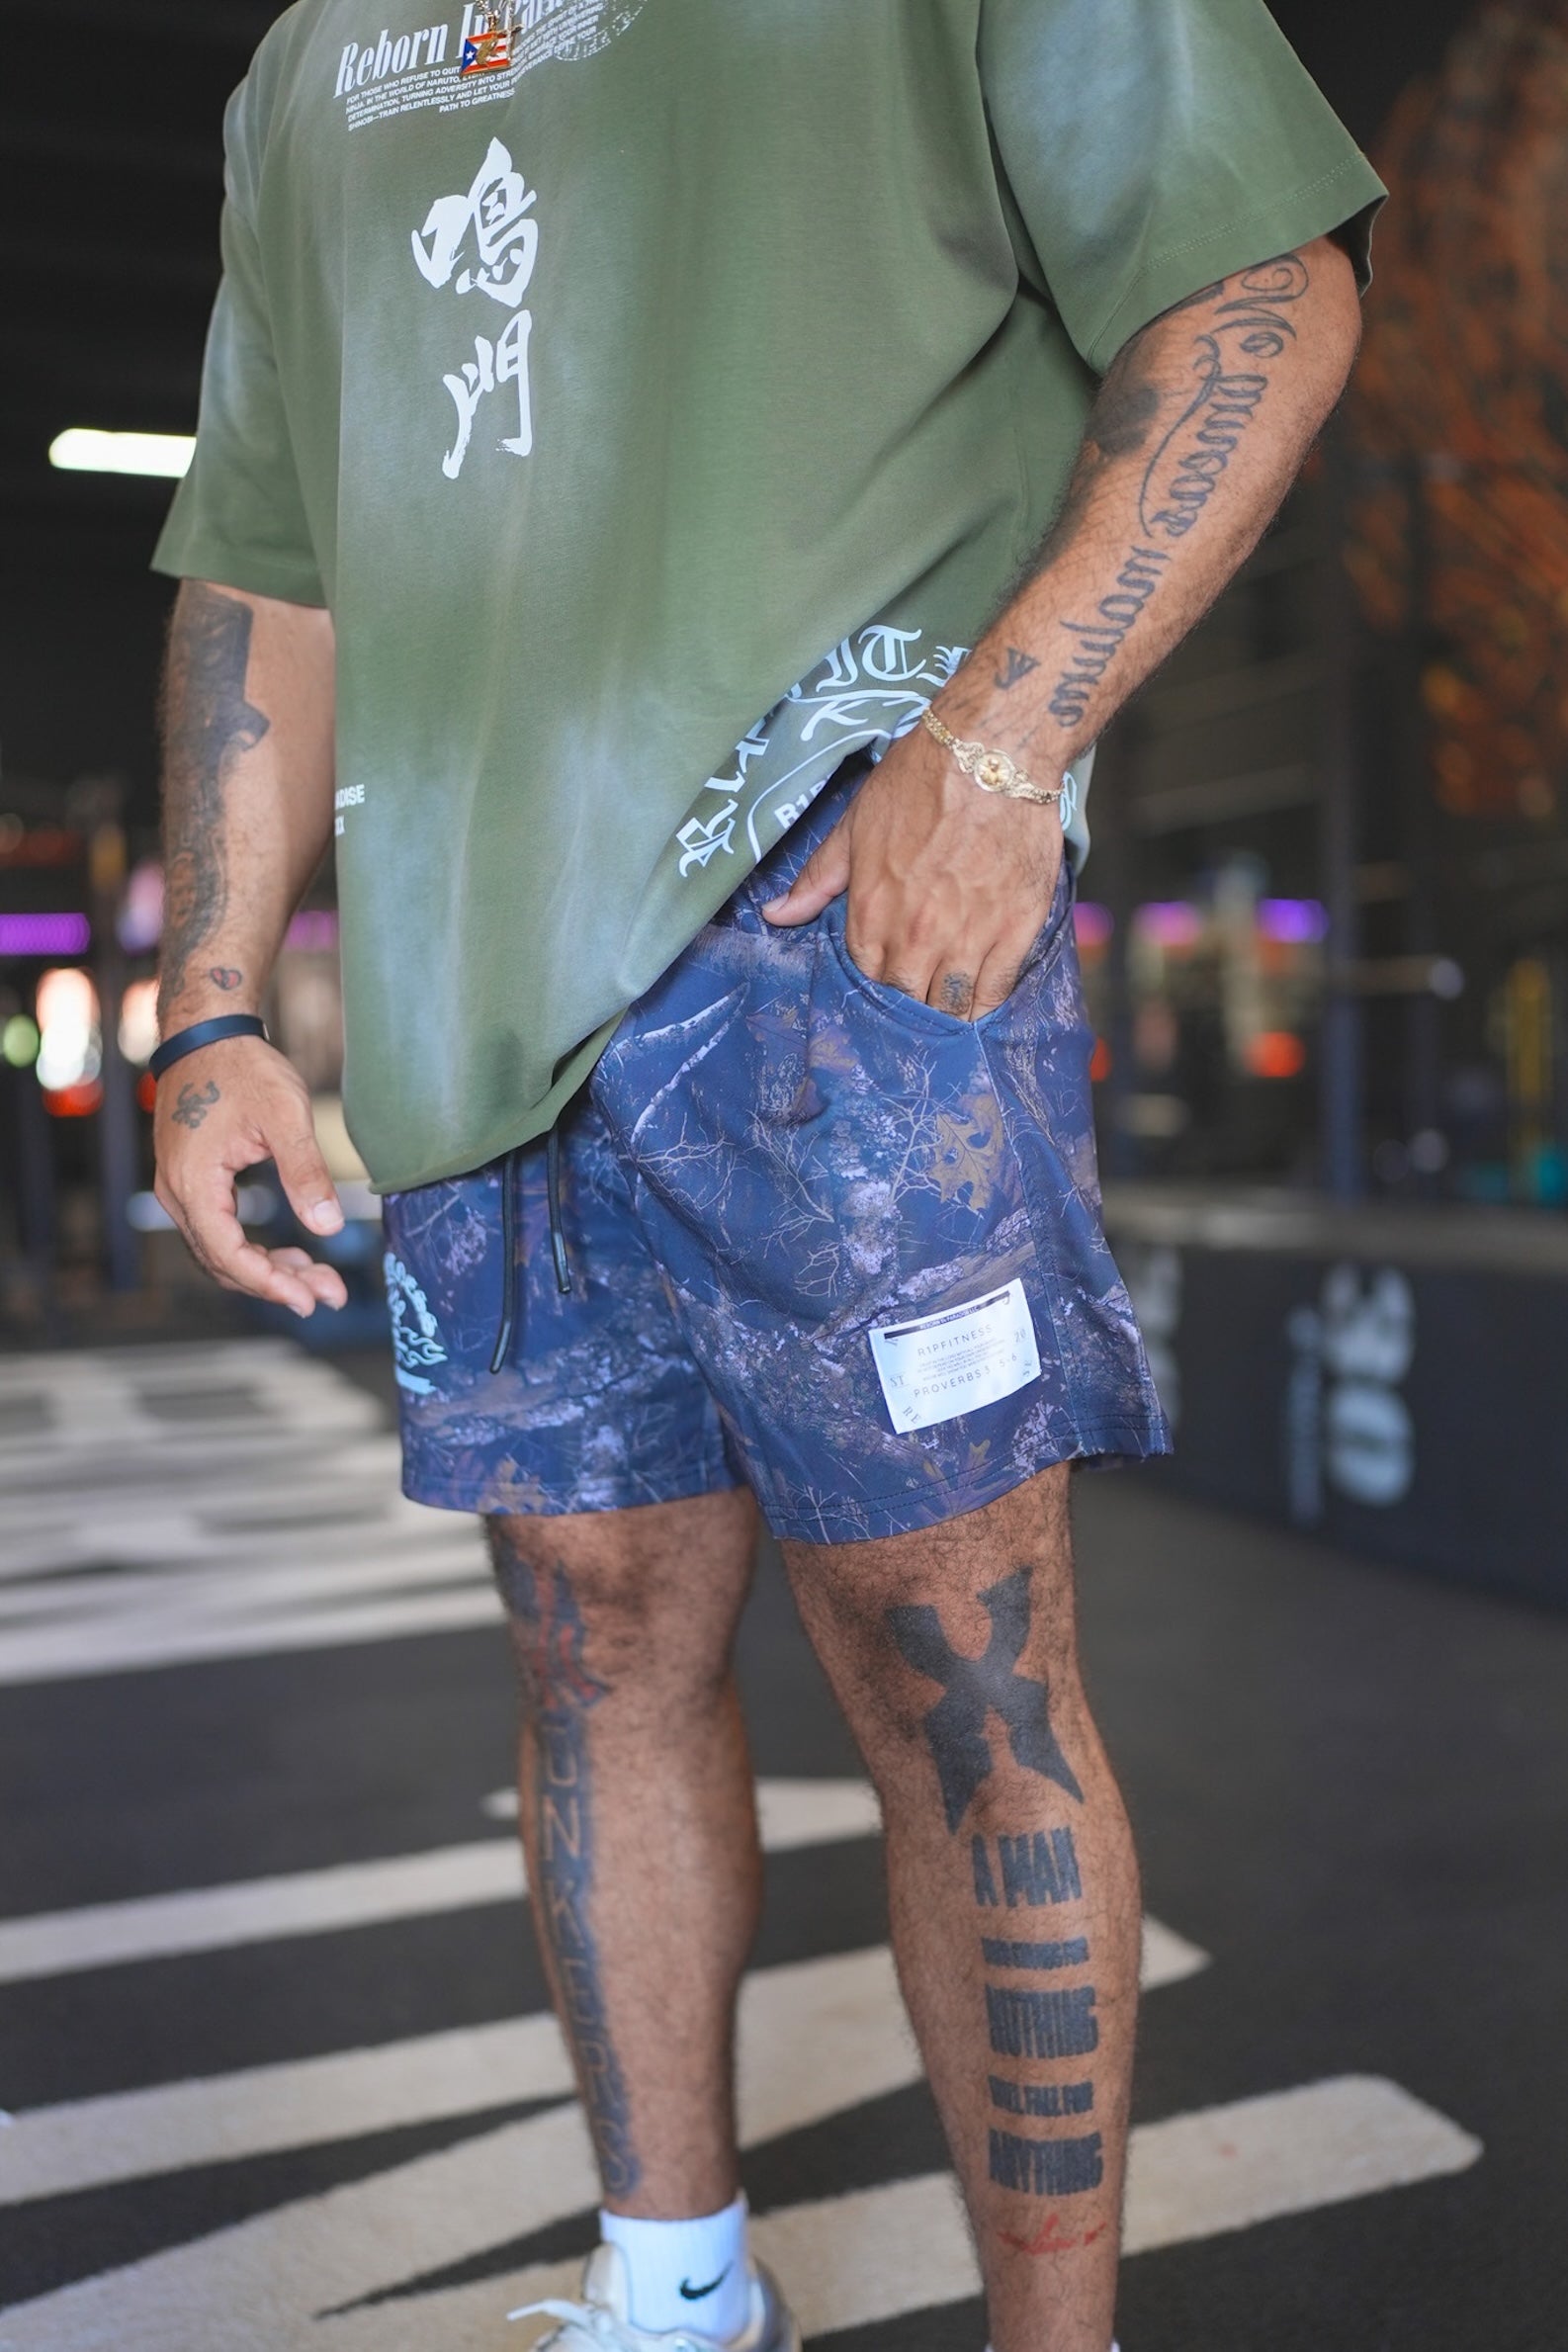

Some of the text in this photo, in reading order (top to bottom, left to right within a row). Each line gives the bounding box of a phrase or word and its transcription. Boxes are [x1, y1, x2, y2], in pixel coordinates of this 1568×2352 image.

[333, 24, 449, 99] Reborn
[346, 95, 360, 106] FOR
[361, 86, 383, 99] THOSE
[384, 80, 399, 92] WHO
[400, 72, 428, 85] REFUSE
[430, 69, 441, 78] TO
[374, 94, 387, 104] THE
[390, 85, 413, 98] WORLD
[415, 82, 425, 91] OF
[400, 95, 455, 112] RELENTLESSLY
[456, 90, 472, 101] AND
[474, 85, 487, 96] LET
[489, 80, 510, 92] YOUR
[401, 89, 433, 102] TURNING
[436, 80, 476, 95] ADVERSITY
[478, 75, 495, 86] INTO
[439, 102, 459, 113] PATH
[472, 87, 515, 106] GREATNESS
[917, 1324, 993, 1357] R1PFITNESS
[914, 1368, 982, 1398] PROVERBS
[998, 1824, 1083, 1908] MAN
